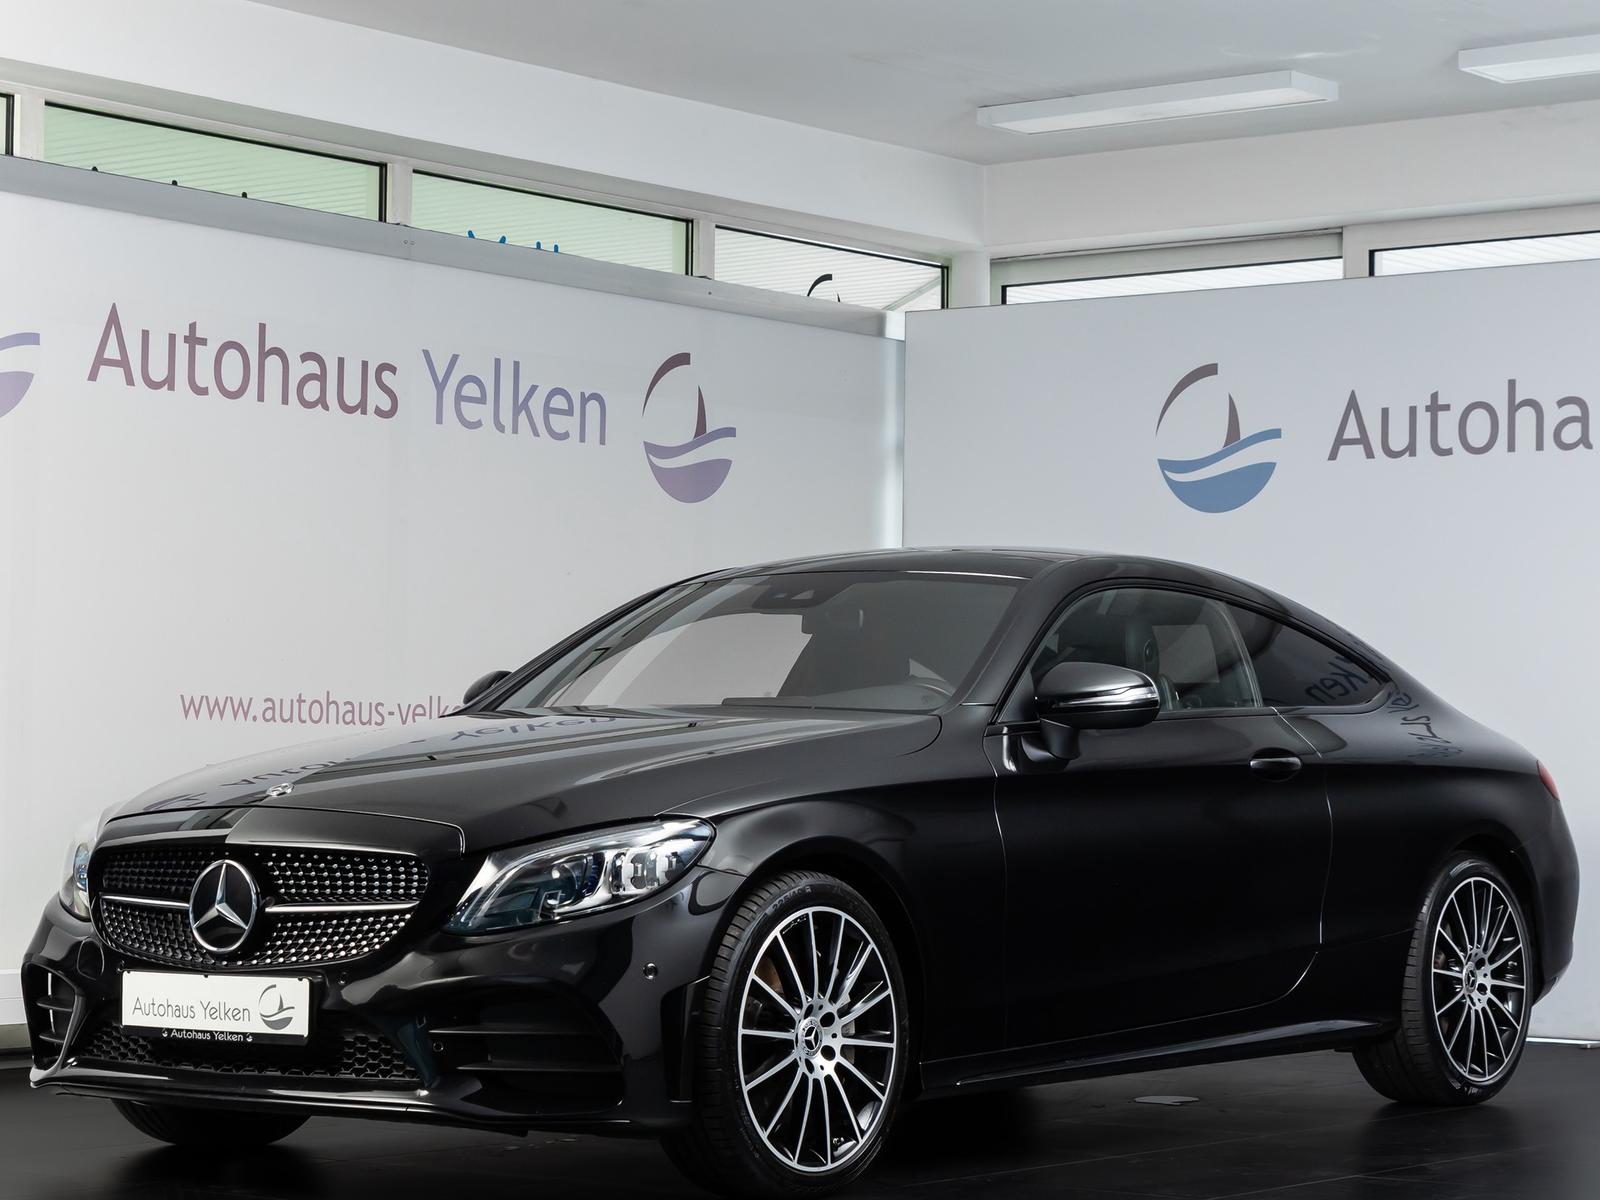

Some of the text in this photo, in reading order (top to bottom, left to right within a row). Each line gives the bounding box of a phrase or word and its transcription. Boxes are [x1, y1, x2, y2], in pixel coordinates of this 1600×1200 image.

[88, 303, 607, 446] Autohaus Yelken
[1327, 379, 1593, 461] Autoha
[132, 997, 251, 1022] Autohaus Yelken
[171, 1029, 243, 1042] Autohaus Yelken
